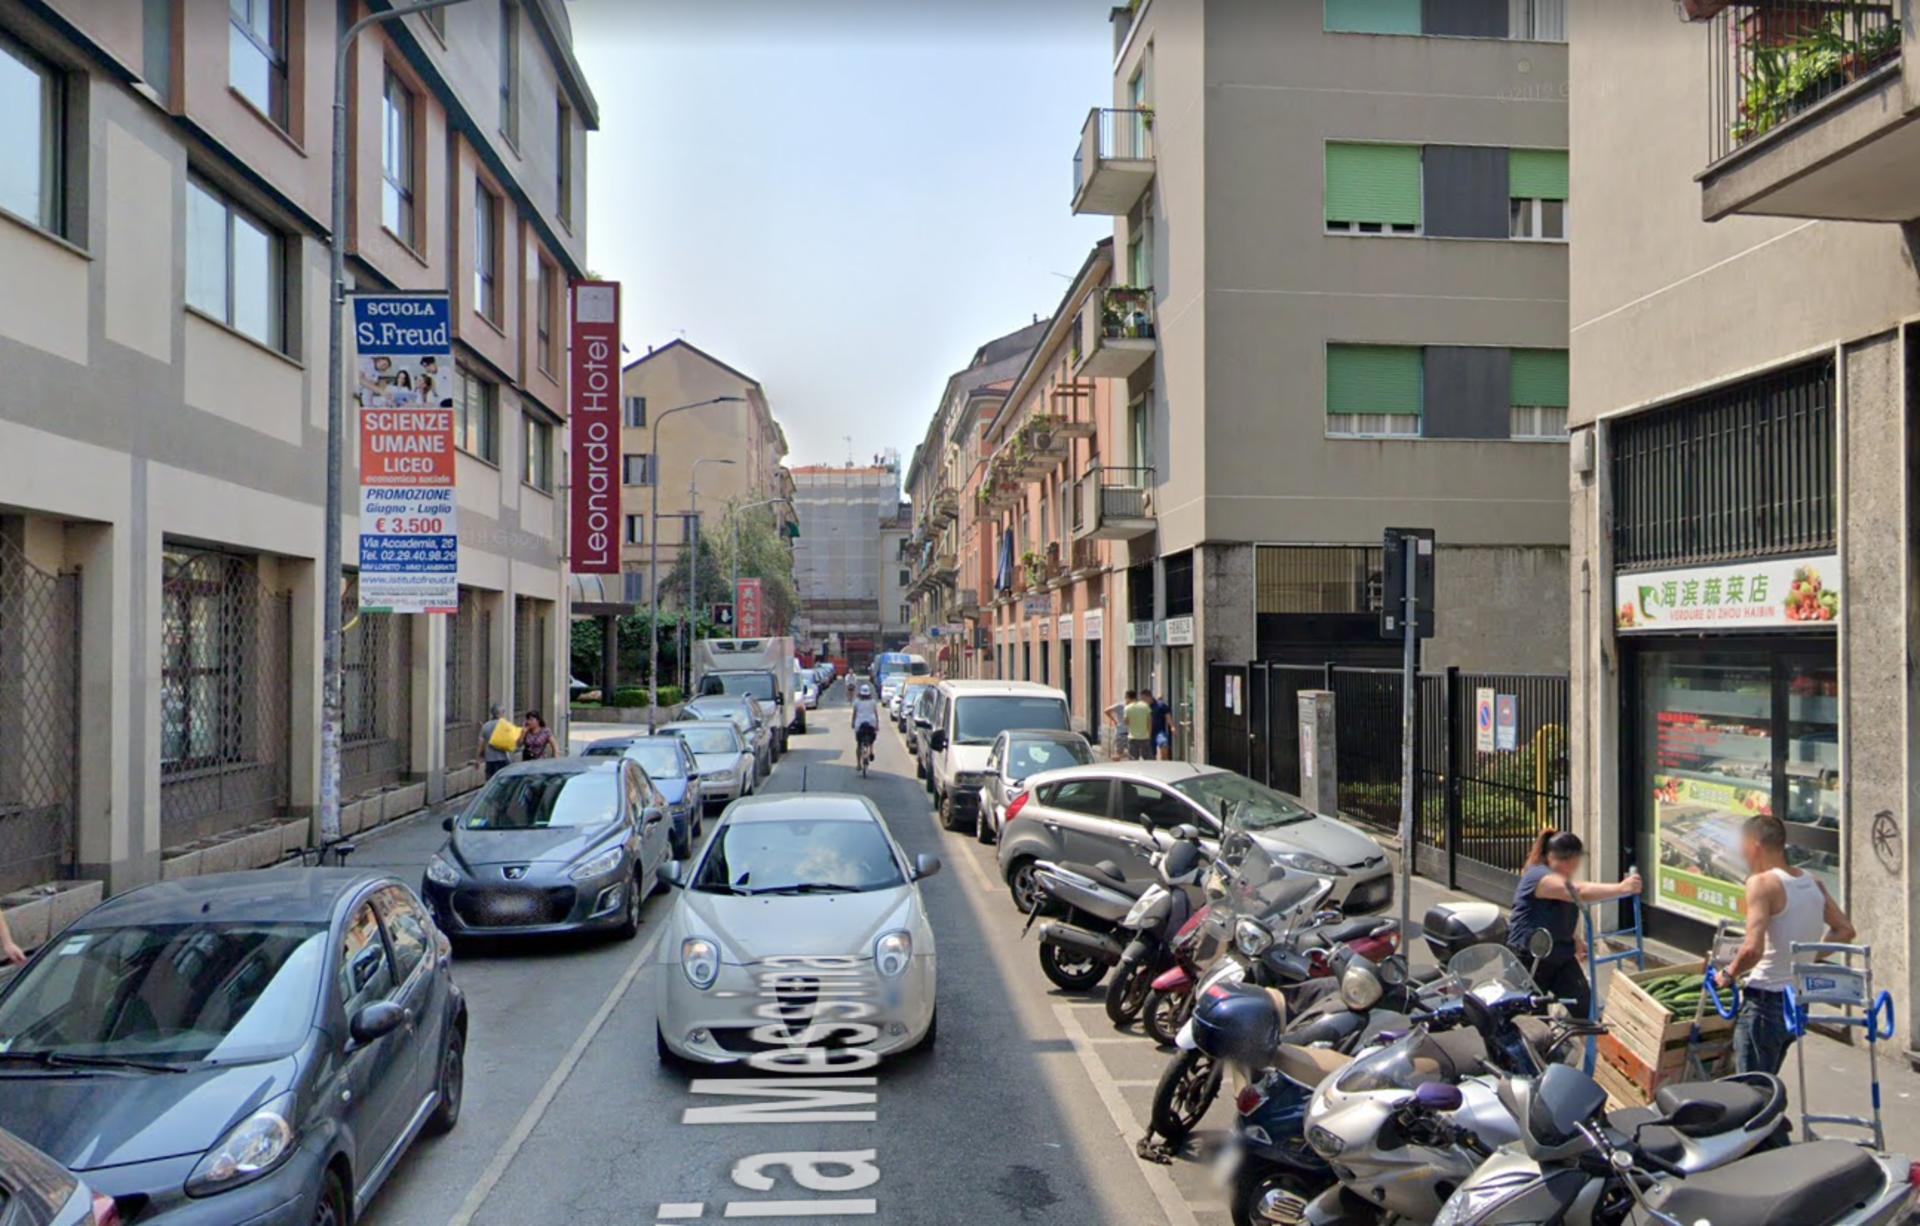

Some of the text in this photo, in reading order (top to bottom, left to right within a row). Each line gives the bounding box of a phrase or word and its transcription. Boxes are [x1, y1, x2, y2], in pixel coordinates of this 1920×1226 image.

[367, 302, 436, 316] SCUOLA
[358, 321, 449, 346] S.Freud
[365, 412, 450, 432] SCIENZE
[371, 434, 446, 453] UMANE
[582, 335, 609, 566] Leonardo Hotel
[383, 457, 434, 473] LICEO
[366, 488, 452, 501] PROMOZIONE
[366, 503, 407, 515] Giugno
[417, 503, 453, 515] Luglio
[375, 517, 443, 534] € 3.500
[363, 537, 380, 548] Via
[1660, 574, 1769, 607] 海滨蔬菜店
